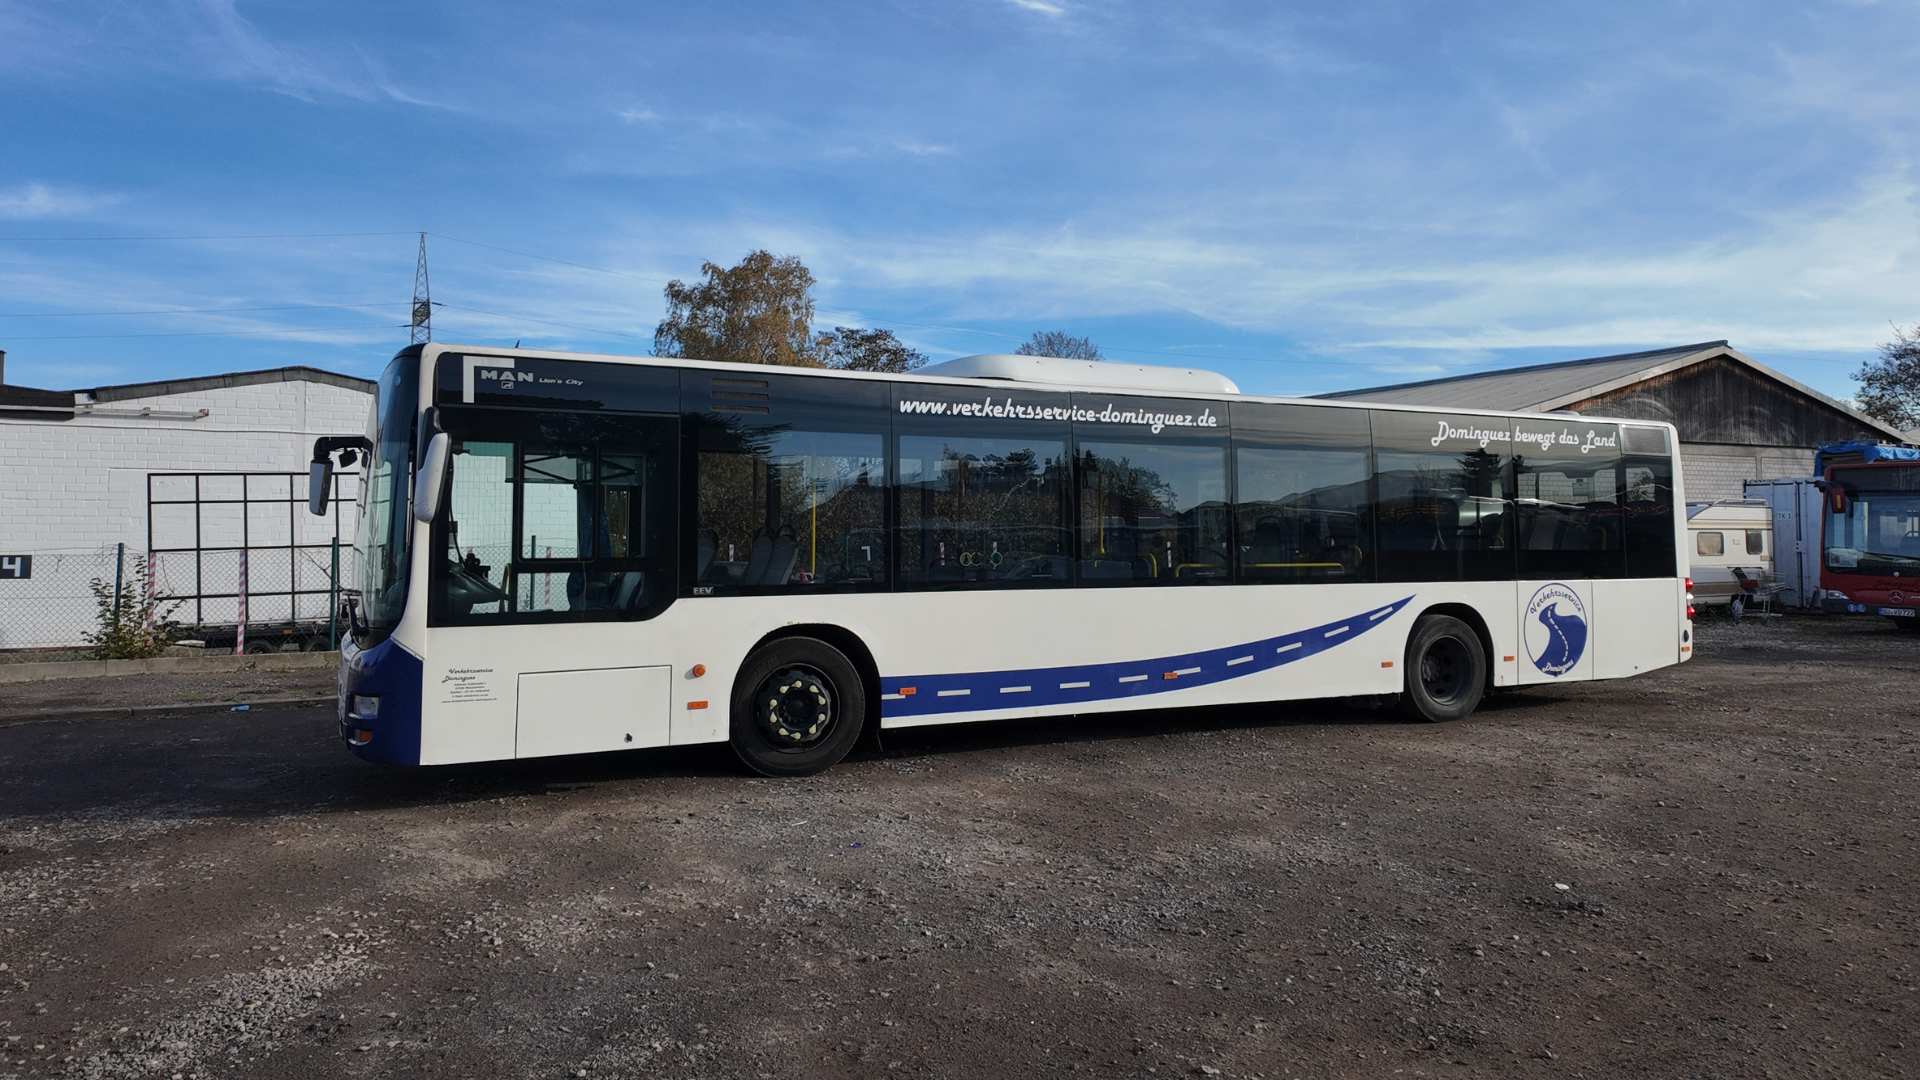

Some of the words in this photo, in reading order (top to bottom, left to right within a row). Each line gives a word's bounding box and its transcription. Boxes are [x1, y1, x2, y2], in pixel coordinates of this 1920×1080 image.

[481, 370, 534, 383] MAN
[565, 378, 584, 386] City
[900, 397, 1217, 434] www.verkehrsservice-dominguez.de
[1431, 421, 1511, 448] Dominguez
[1514, 426, 1556, 451] bewegt
[1559, 429, 1579, 445] das
[1581, 430, 1616, 454] Land
[693, 586, 714, 595] EEV
[1530, 588, 1582, 614] Verkehrsservice
[1541, 659, 1574, 674] Dominguez
